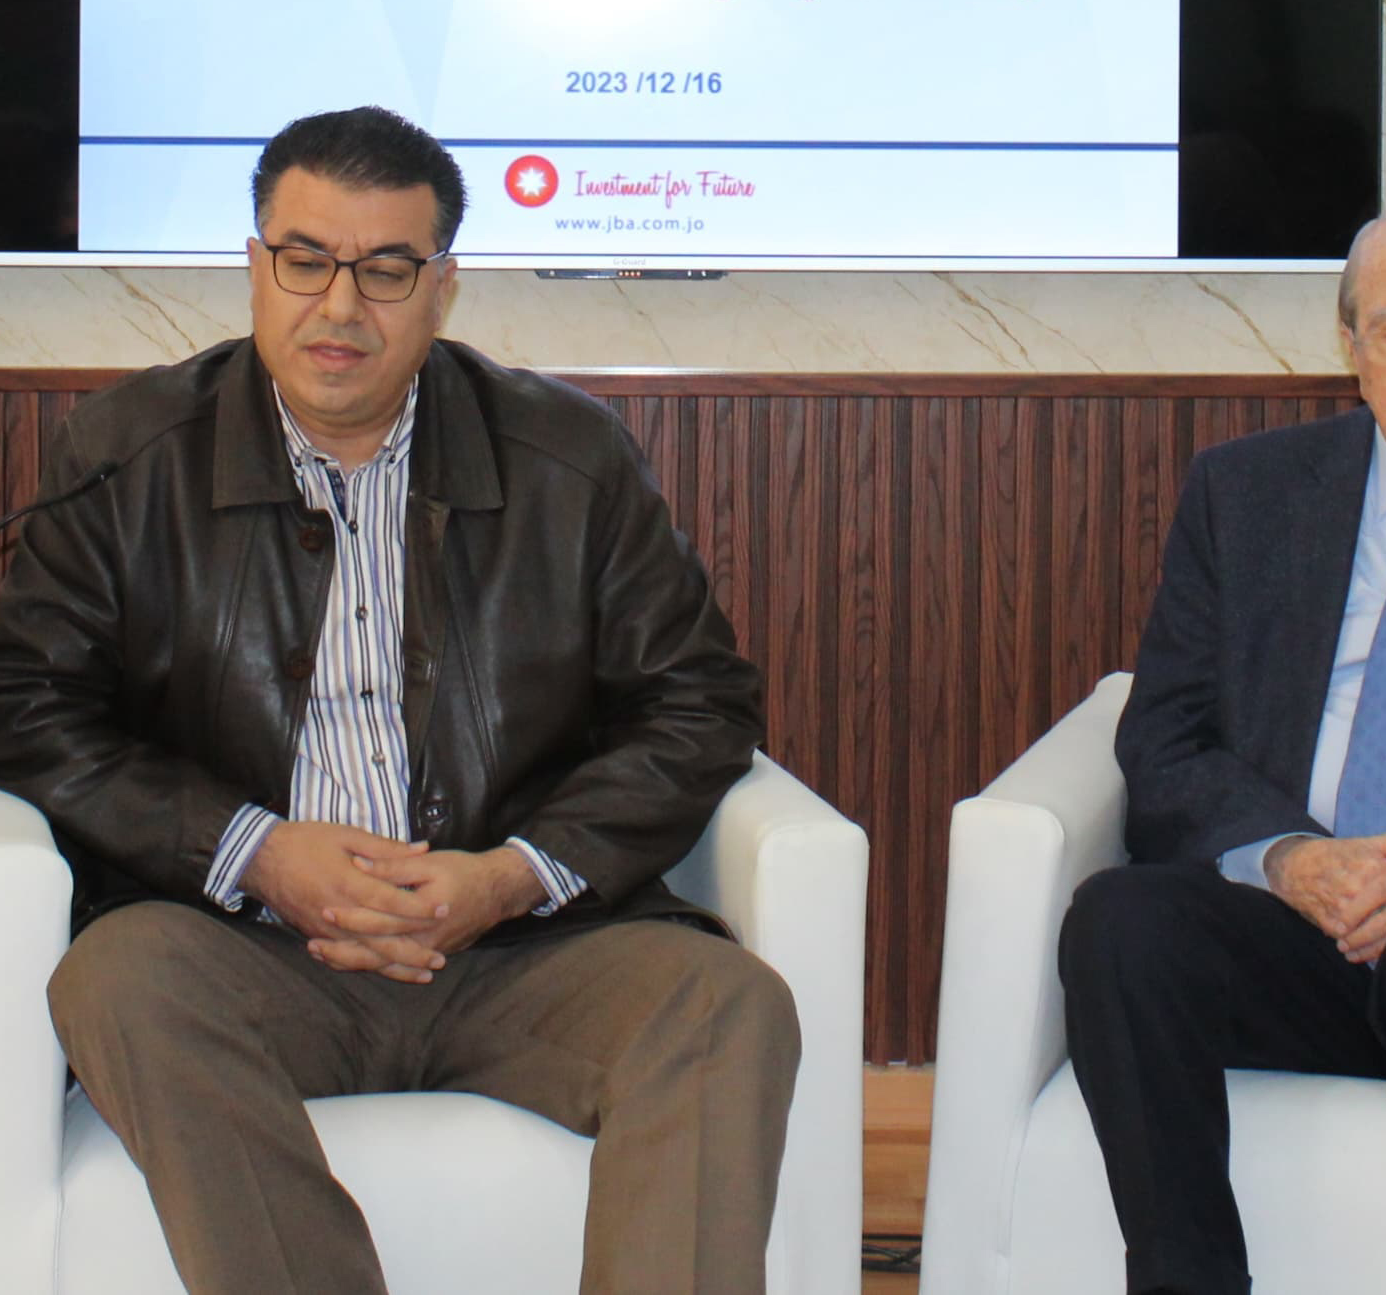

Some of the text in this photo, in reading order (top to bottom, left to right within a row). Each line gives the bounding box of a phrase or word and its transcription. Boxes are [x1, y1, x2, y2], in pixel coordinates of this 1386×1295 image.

[565, 70, 723, 94] 2023 /12 /16
[574, 169, 756, 209] Investment for Future
[554, 214, 706, 235] www.jba.com.jo
